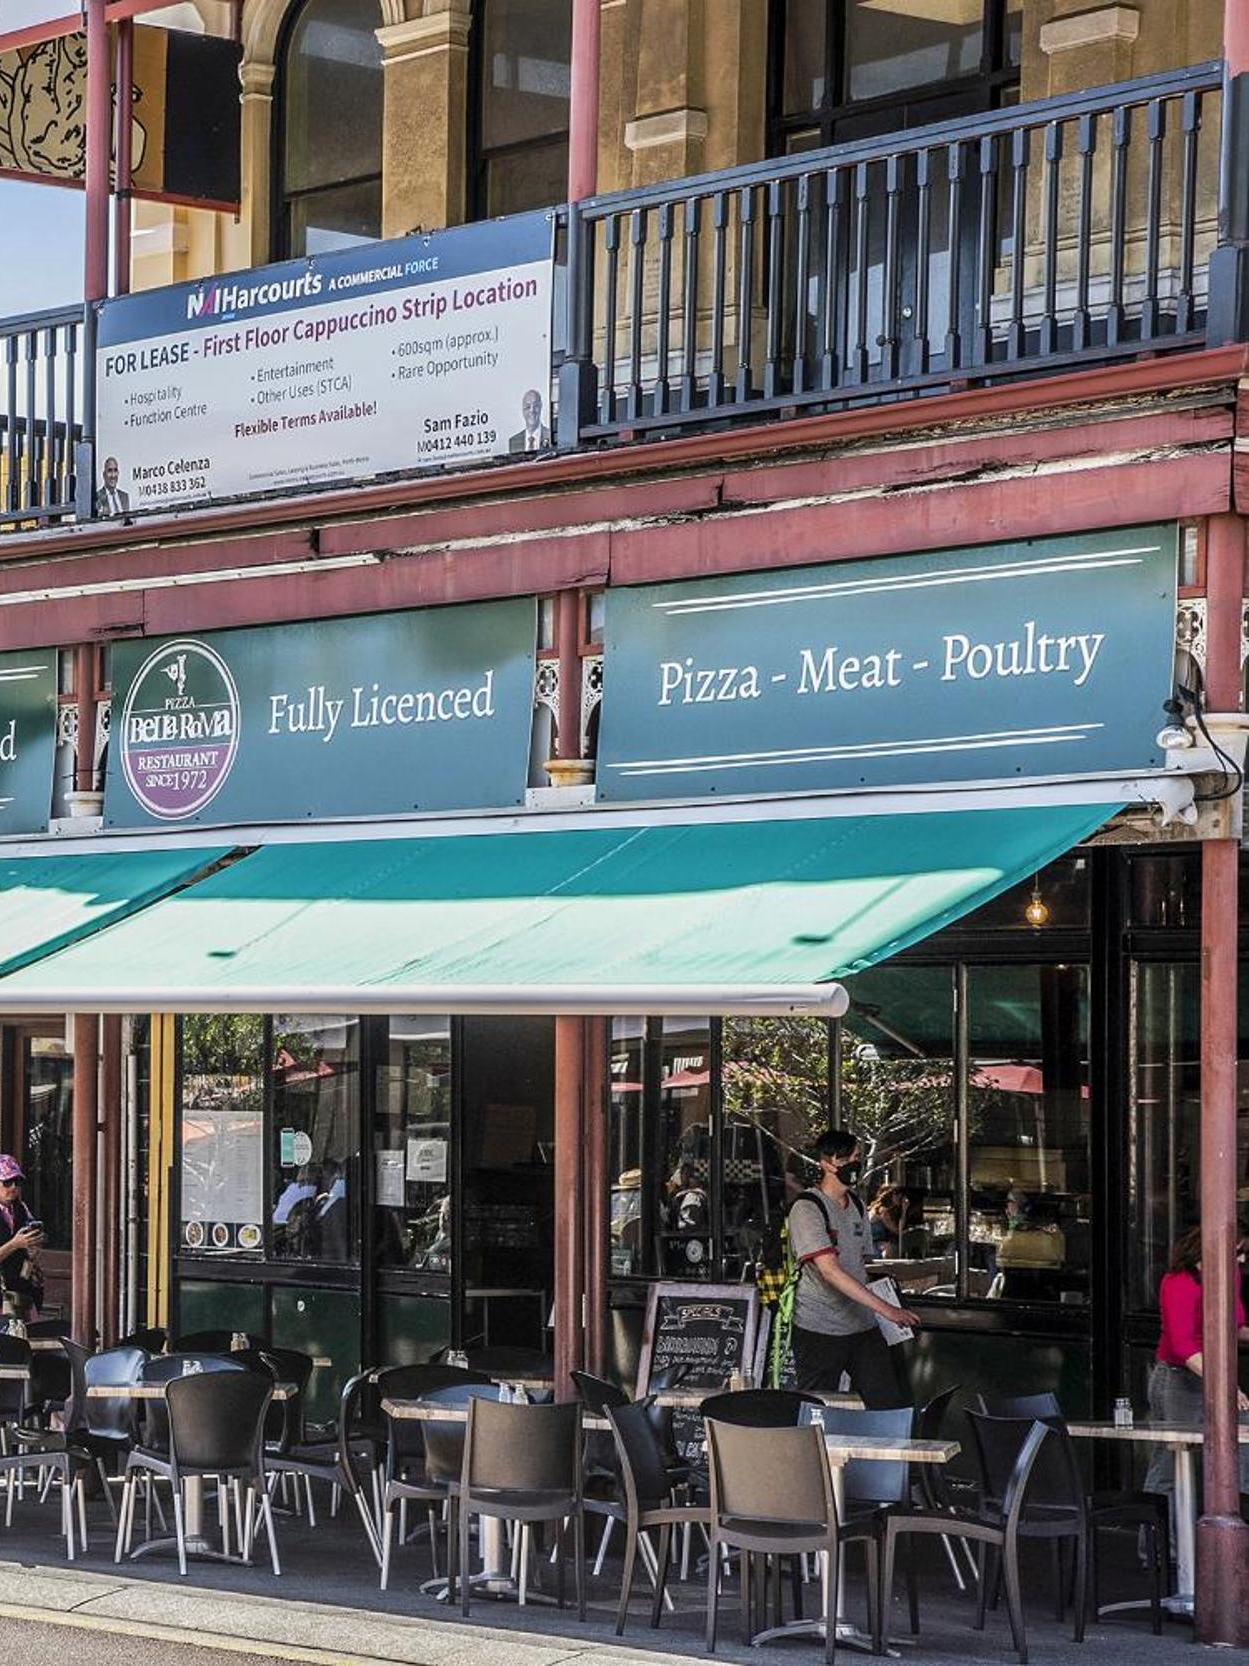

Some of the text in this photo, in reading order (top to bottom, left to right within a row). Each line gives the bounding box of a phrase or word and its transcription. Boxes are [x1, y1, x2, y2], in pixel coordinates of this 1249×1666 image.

[328, 257, 439, 291] A COMMERCIAL FORCE
[105, 353, 137, 377] FOR
[140, 342, 190, 370] LEASE
[203, 333, 241, 358] First
[245, 326, 290, 350] Floor
[293, 304, 397, 342] Cappuccino
[402, 292, 447, 320] Strip
[453, 277, 538, 312] Location
[398, 337, 444, 359] 600sqm
[257, 358, 334, 383] Entertainment
[398, 353, 499, 381] Rare Opportunity
[130, 385, 183, 405] Hospitality
[257, 387, 287, 405] Other
[289, 384, 314, 399] Uses
[130, 402, 208, 428] Function Centre
[234, 400, 378, 438] Flexible Terms Available!
[423, 409, 489, 433] Sam Fazio
[454, 433, 474, 449] 440
[477, 430, 497, 445] 139
[133, 456, 211, 481] Marco Celenza
[658, 656, 761, 706] Pizza
[797, 646, 902, 694] Meat
[941, 621, 1106, 686] Poultry
[165, 696, 196, 711] PIZZA
[268, 670, 495, 742] Fully Licenced
[138, 751, 219, 771] RESTAURANT
